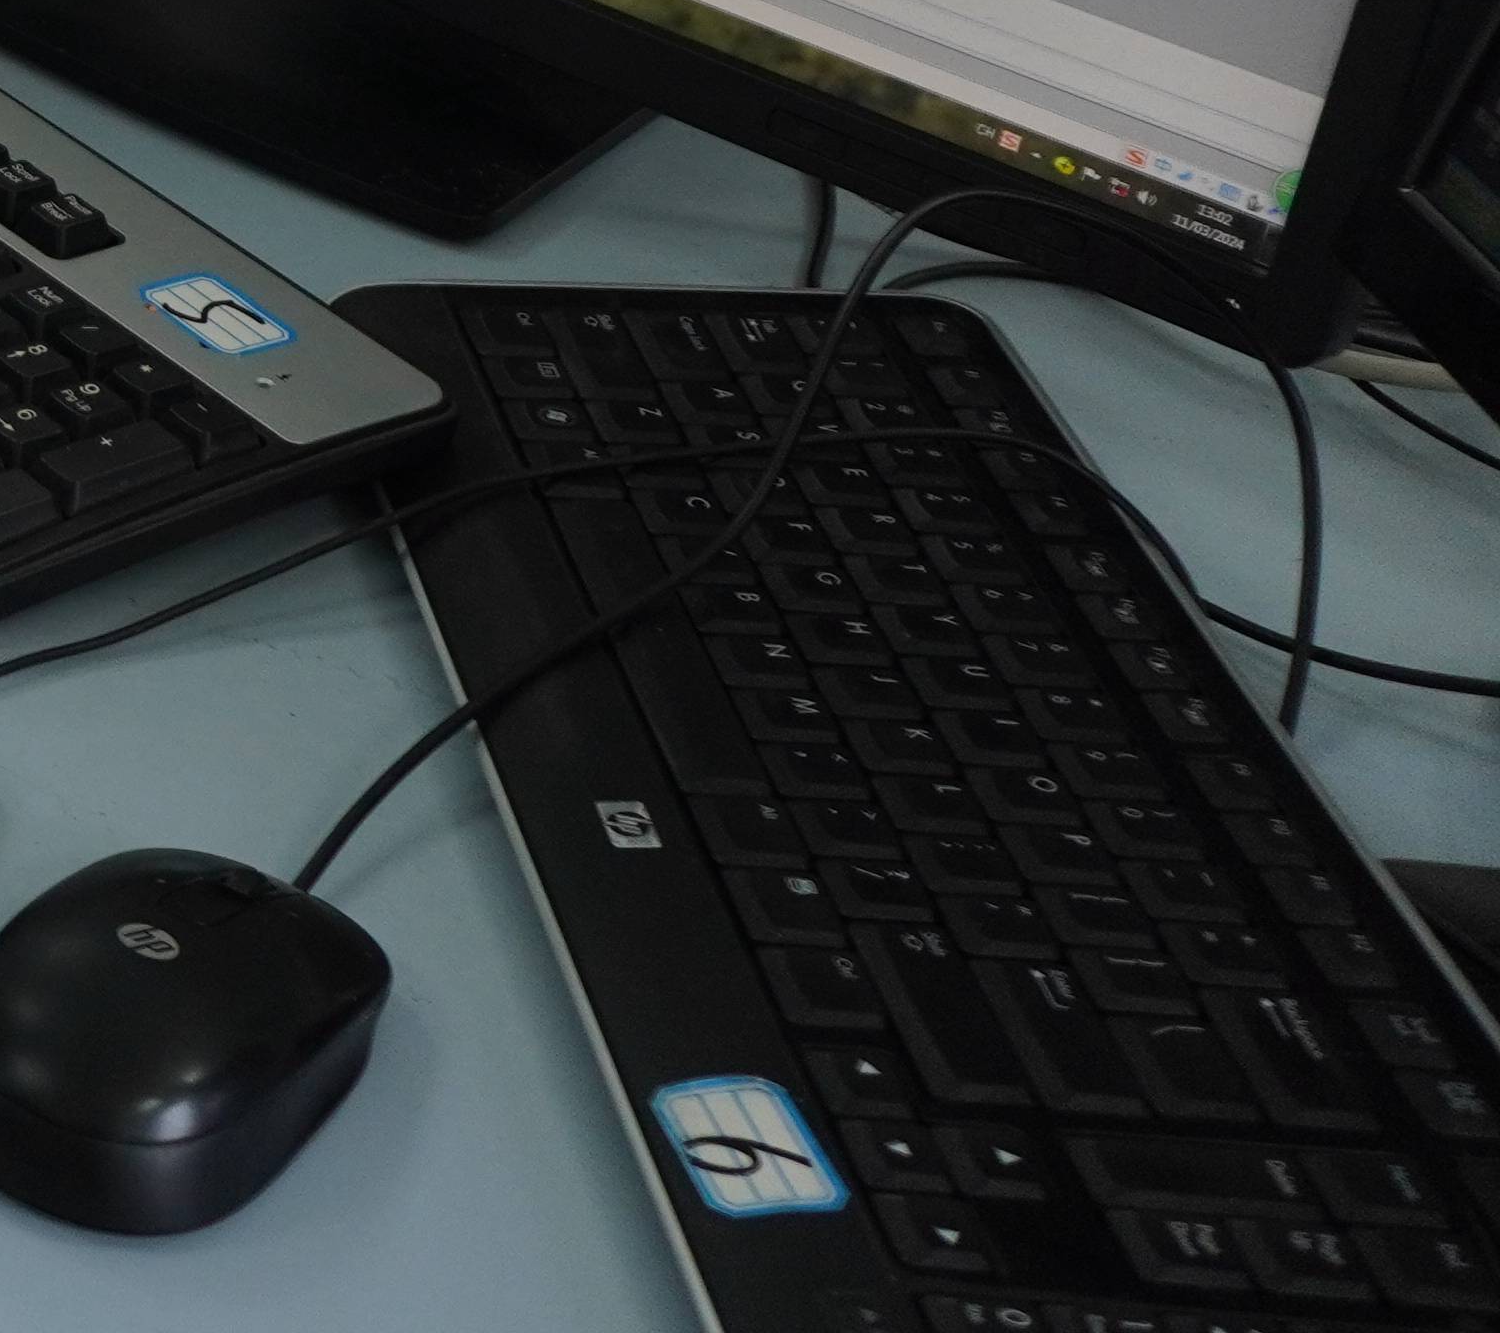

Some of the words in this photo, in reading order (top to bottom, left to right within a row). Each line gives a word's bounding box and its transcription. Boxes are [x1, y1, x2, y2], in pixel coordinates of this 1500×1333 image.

[1197, 203, 1235, 228] 13:02
[1171, 213, 1248, 251] 11/03/2024
[28, 344, 48, 356] 8
[79, 383, 101, 396] 9
[16, 408, 38, 421] 6
[841, 466, 869, 479] E
[814, 570, 842, 586] G
[843, 620, 873, 636] H
[763, 642, 793, 660] N
[958, 663, 990, 677] U
[788, 696, 820, 716] M
[902, 726, 935, 741] K
[1061, 832, 1092, 847] P
[115, 921, 181, 961] hp
